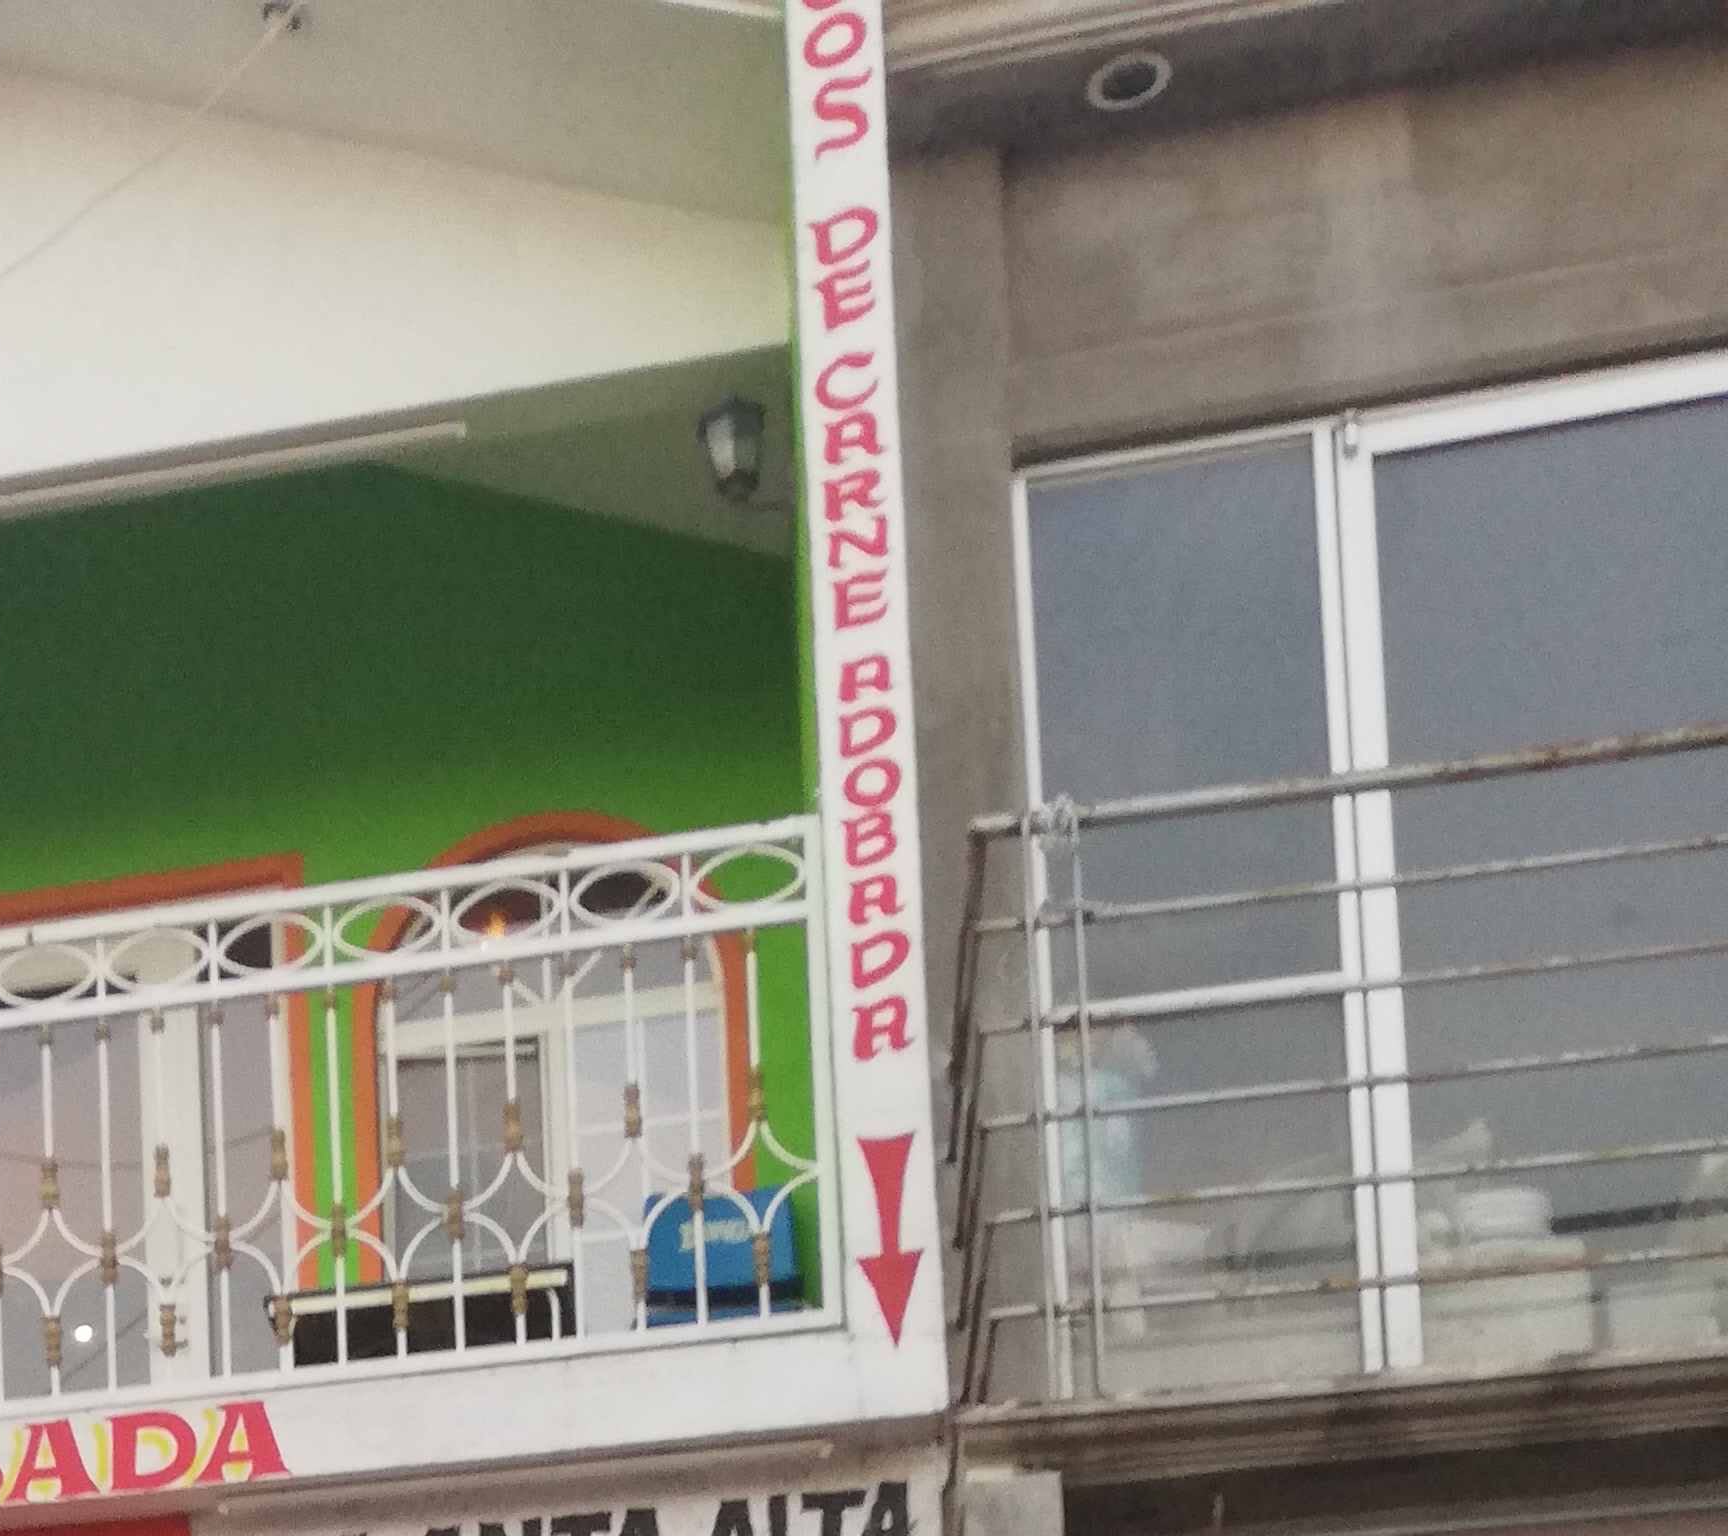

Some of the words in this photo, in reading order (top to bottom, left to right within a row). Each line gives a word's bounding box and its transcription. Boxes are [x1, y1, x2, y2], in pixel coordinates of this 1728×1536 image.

[802, 0, 872, 161] OS
[808, 206, 879, 332] DE
[815, 352, 889, 631] CARNE
[837, 655, 913, 1061] ADOBADA
